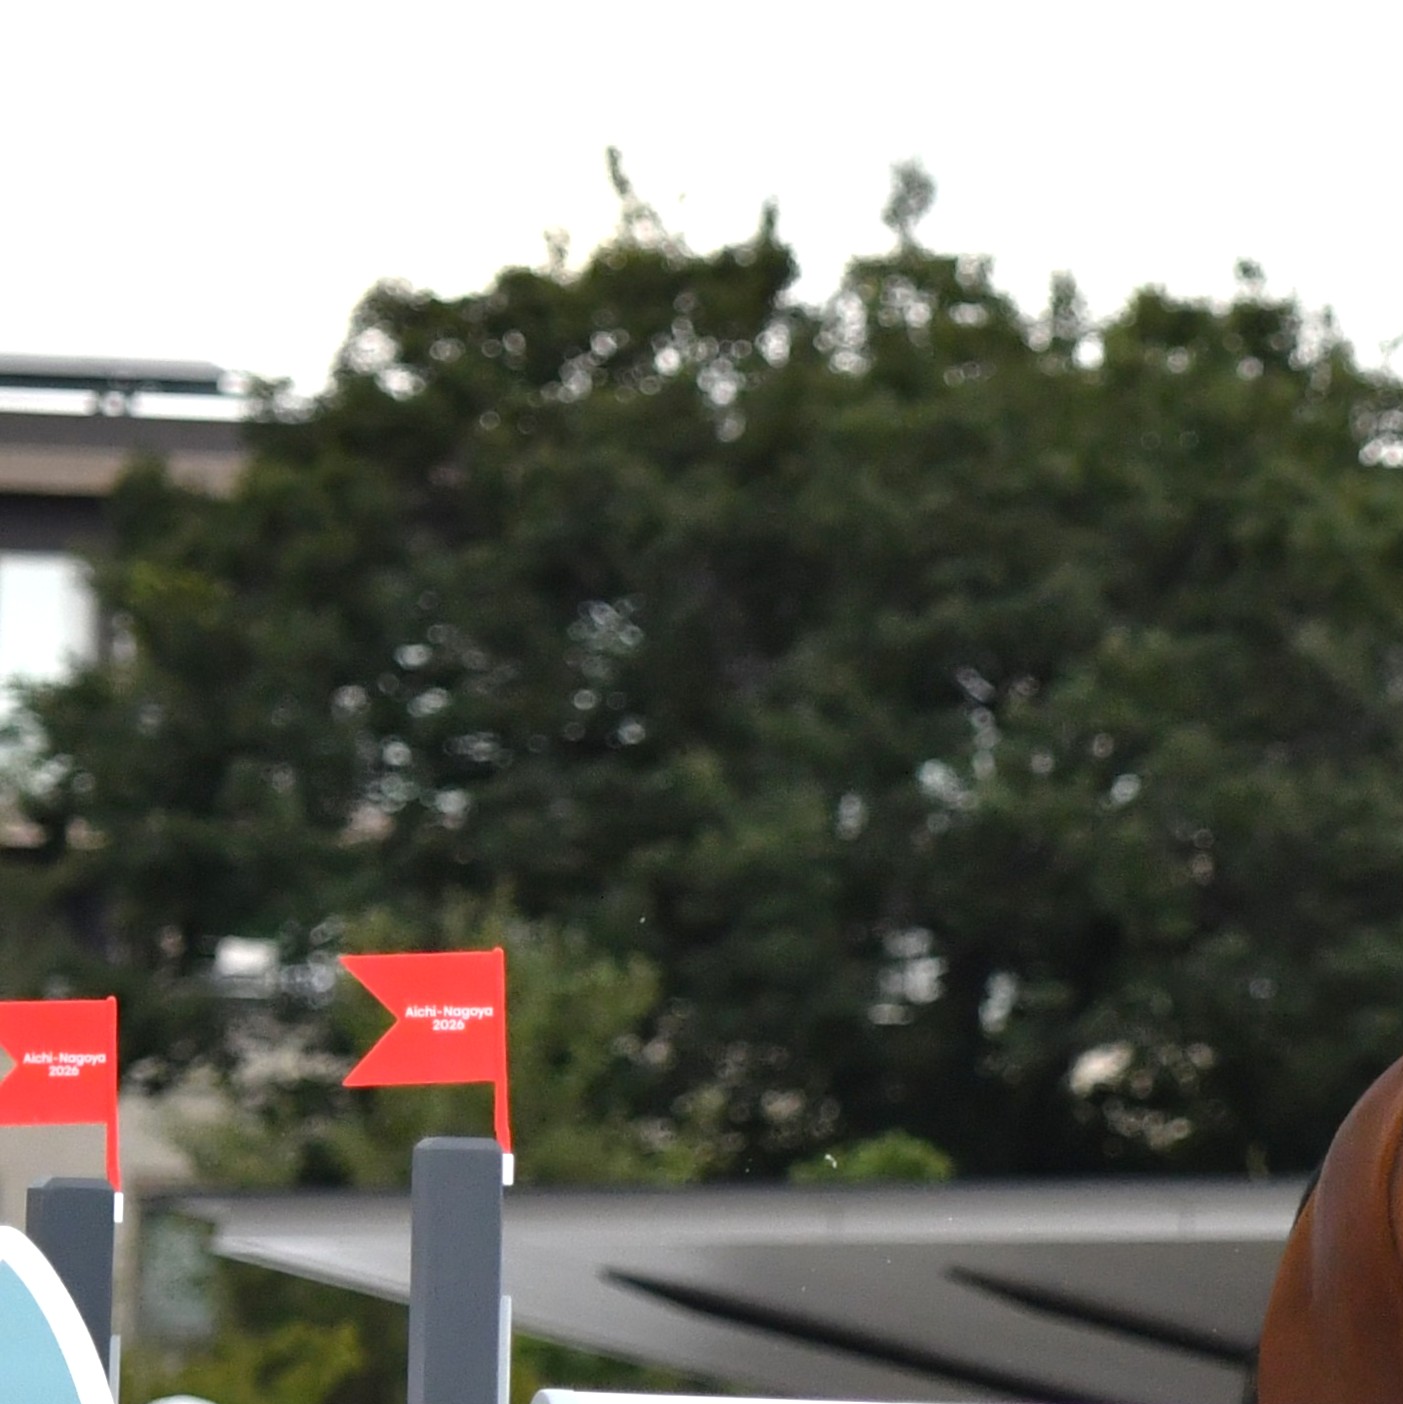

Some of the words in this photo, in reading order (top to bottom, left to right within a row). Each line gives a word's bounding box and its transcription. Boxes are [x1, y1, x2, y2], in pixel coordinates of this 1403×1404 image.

[404, 1005, 494, 1020] Aichi-Nagoya
[432, 1019, 466, 1031] 2026
[23, 1052, 107, 1067] Aichi-Nagoya
[48, 1065, 80, 1077] 2026
